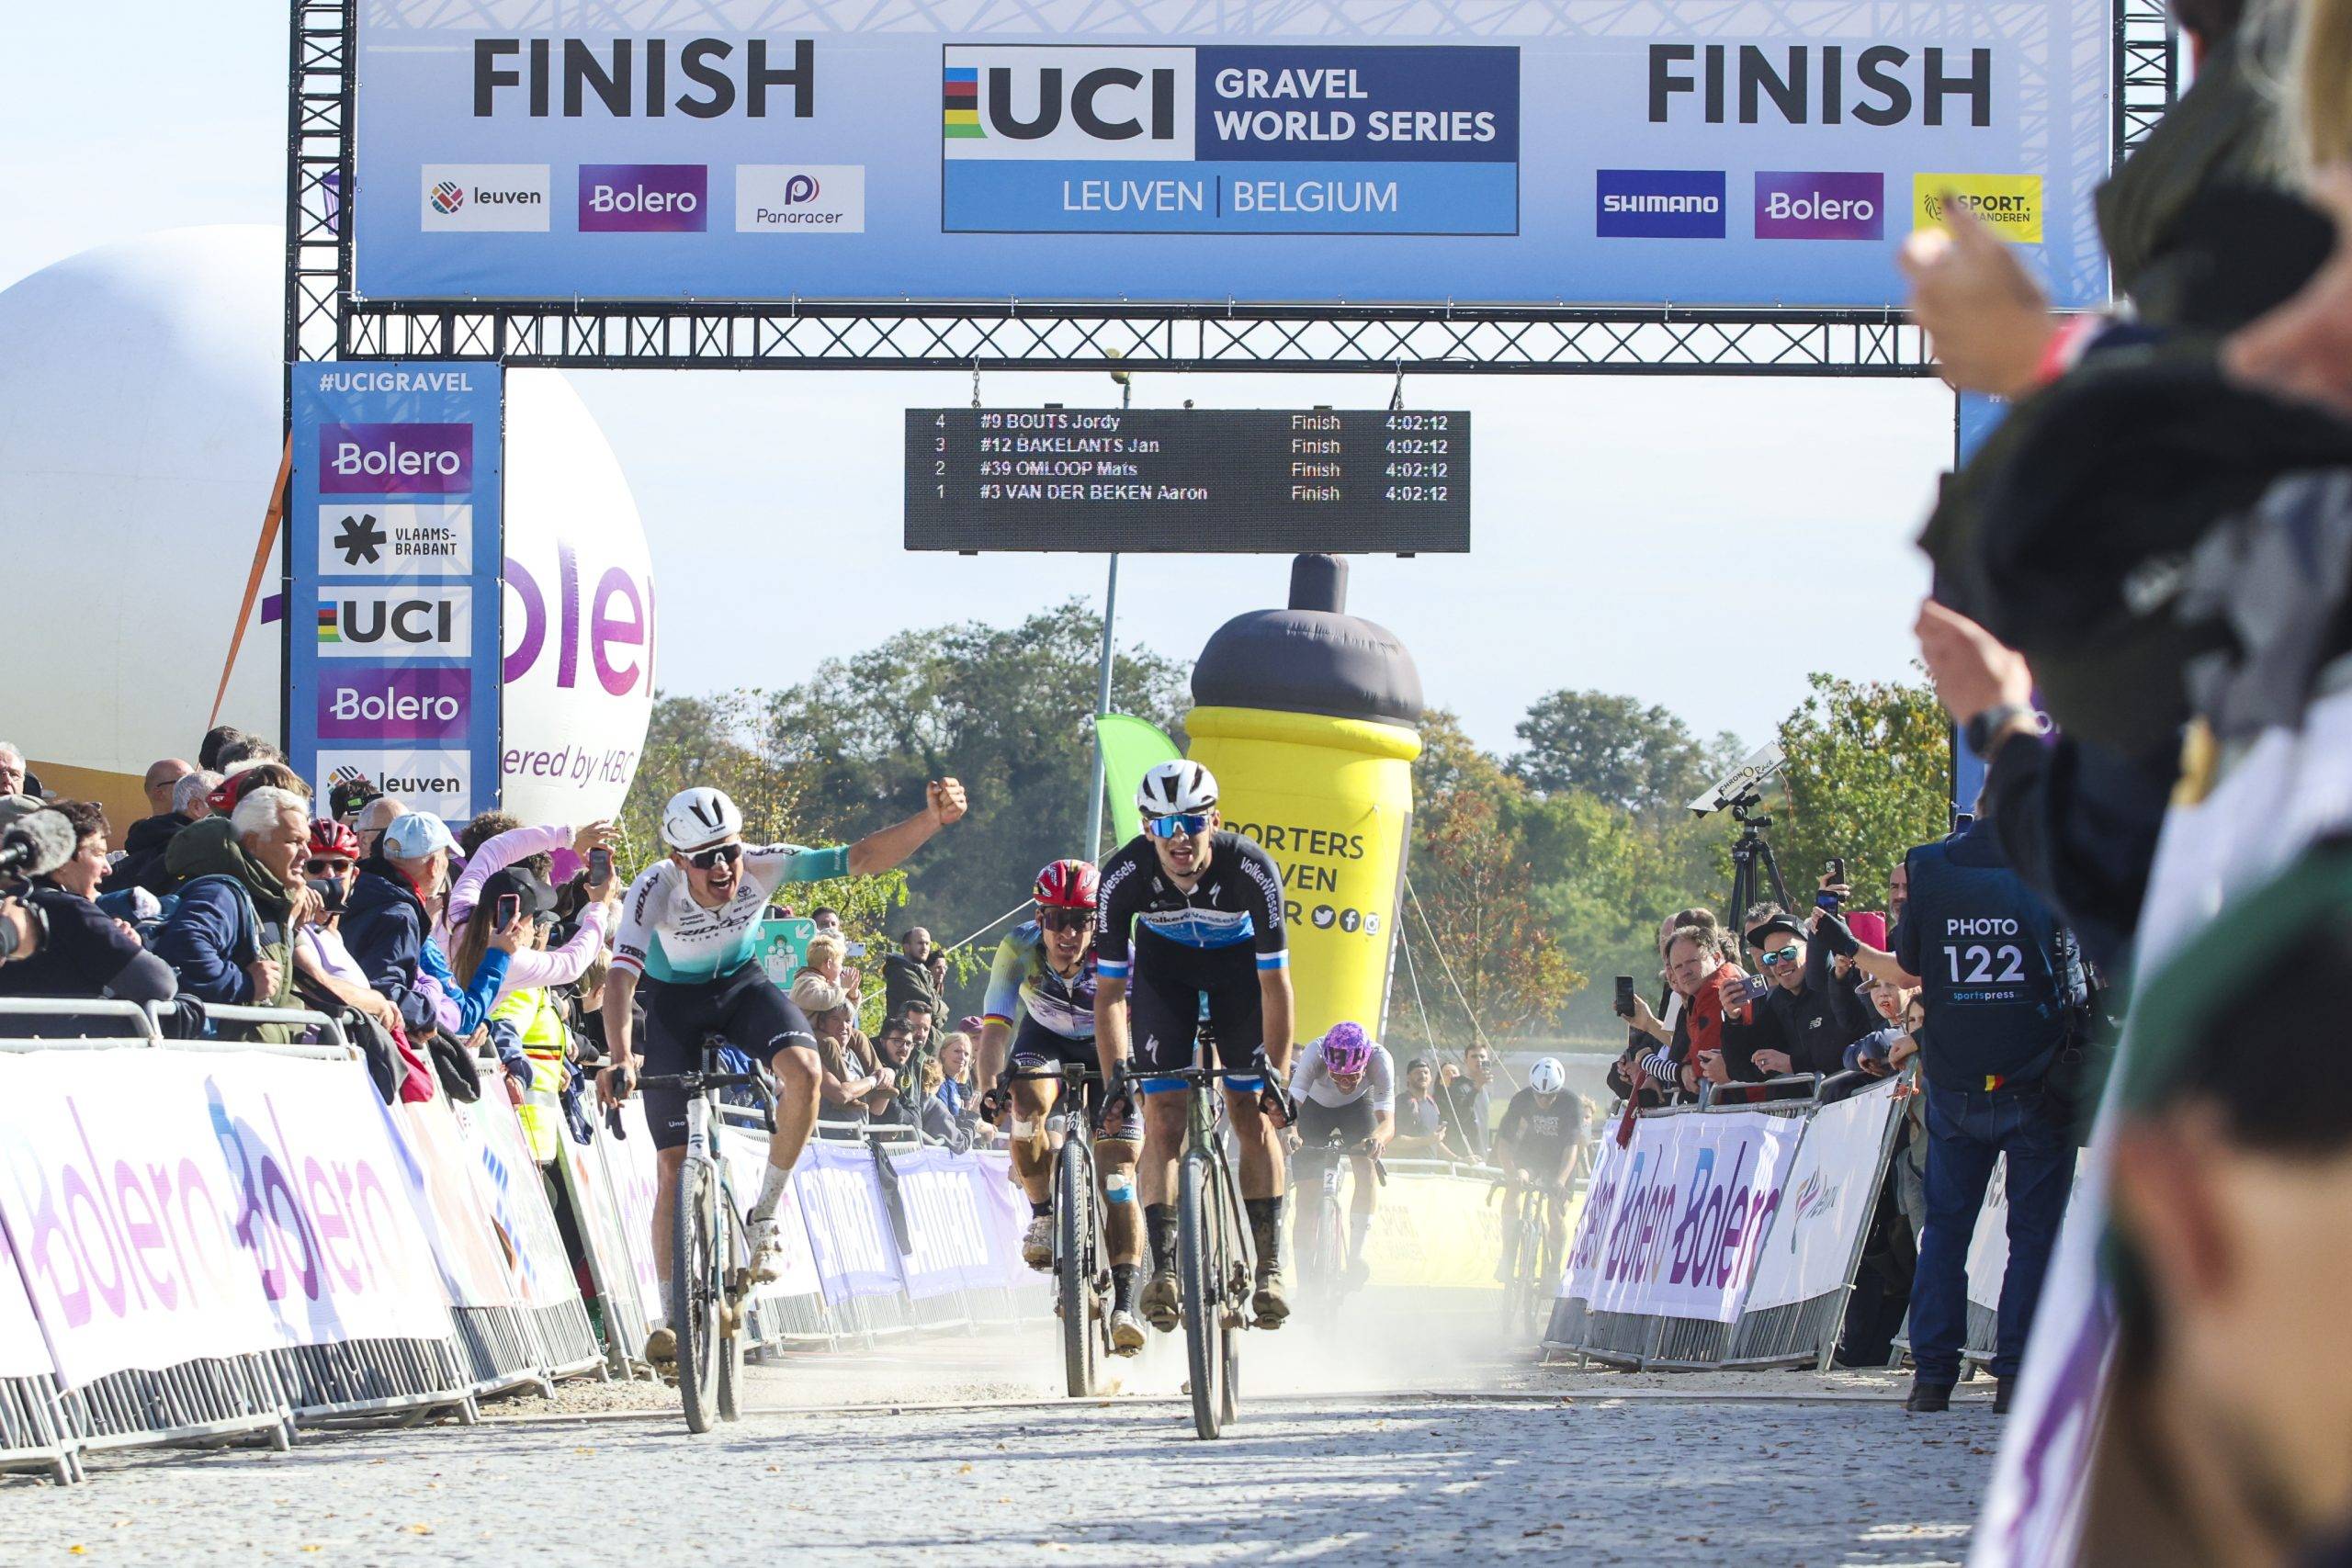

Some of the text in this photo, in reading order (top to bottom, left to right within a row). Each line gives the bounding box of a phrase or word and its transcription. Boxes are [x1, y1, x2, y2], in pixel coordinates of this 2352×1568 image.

[473, 38, 815, 119] FINISH
[1215, 68, 1368, 99] GRAVEL
[1648, 43, 1991, 127] FINISH
[988, 67, 1175, 141] UCI
[1214, 110, 1496, 143] WORLD SERIES
[473, 186, 541, 206] leuven
[588, 185, 697, 214] Bolero
[1063, 180, 1397, 212] LEUVEN BELGIUM
[1603, 195, 1720, 214] SHIMANO
[1764, 190, 1874, 221] Bolero
[1958, 195, 2030, 212] SPORT.
[755, 208, 843, 225] Panaracer
[319, 372, 473, 392] #UCIGRAVEL
[935, 413, 1449, 433] 4 #9 BOUTS Jordy Finish 4:02:12
[331, 442, 460, 476] Bolero
[934, 437, 1449, 454] 3 #12 BAKELANTS Jan Finish 4:02:12
[934, 460, 1449, 478] 2 #39 OMLOOP Mats Finish 4:02:12
[936, 484, 1449, 501] 1 #3 VAN DER BEKEN Aaron Finish 4:02:12
[395, 527, 457, 541] VLAAMS-
[395, 542, 458, 556] BRABANT
[343, 600, 451, 643] UCI
[330, 688, 458, 721] Bolero
[503, 744, 571, 777] ered
[571, 748, 600, 789] by
[379, 772, 460, 794] leuven
[634, 873, 659, 927] RIDLEY
[1098, 859, 1136, 934] VolkerWessels
[1240, 856, 1279, 931] VolkerWessels
[1947, 918, 2018, 936] PHOTO
[1943, 945, 2025, 983] 122
[1953, 990, 2015, 1001] sportspress
[668, 1119, 685, 1128] Uno
